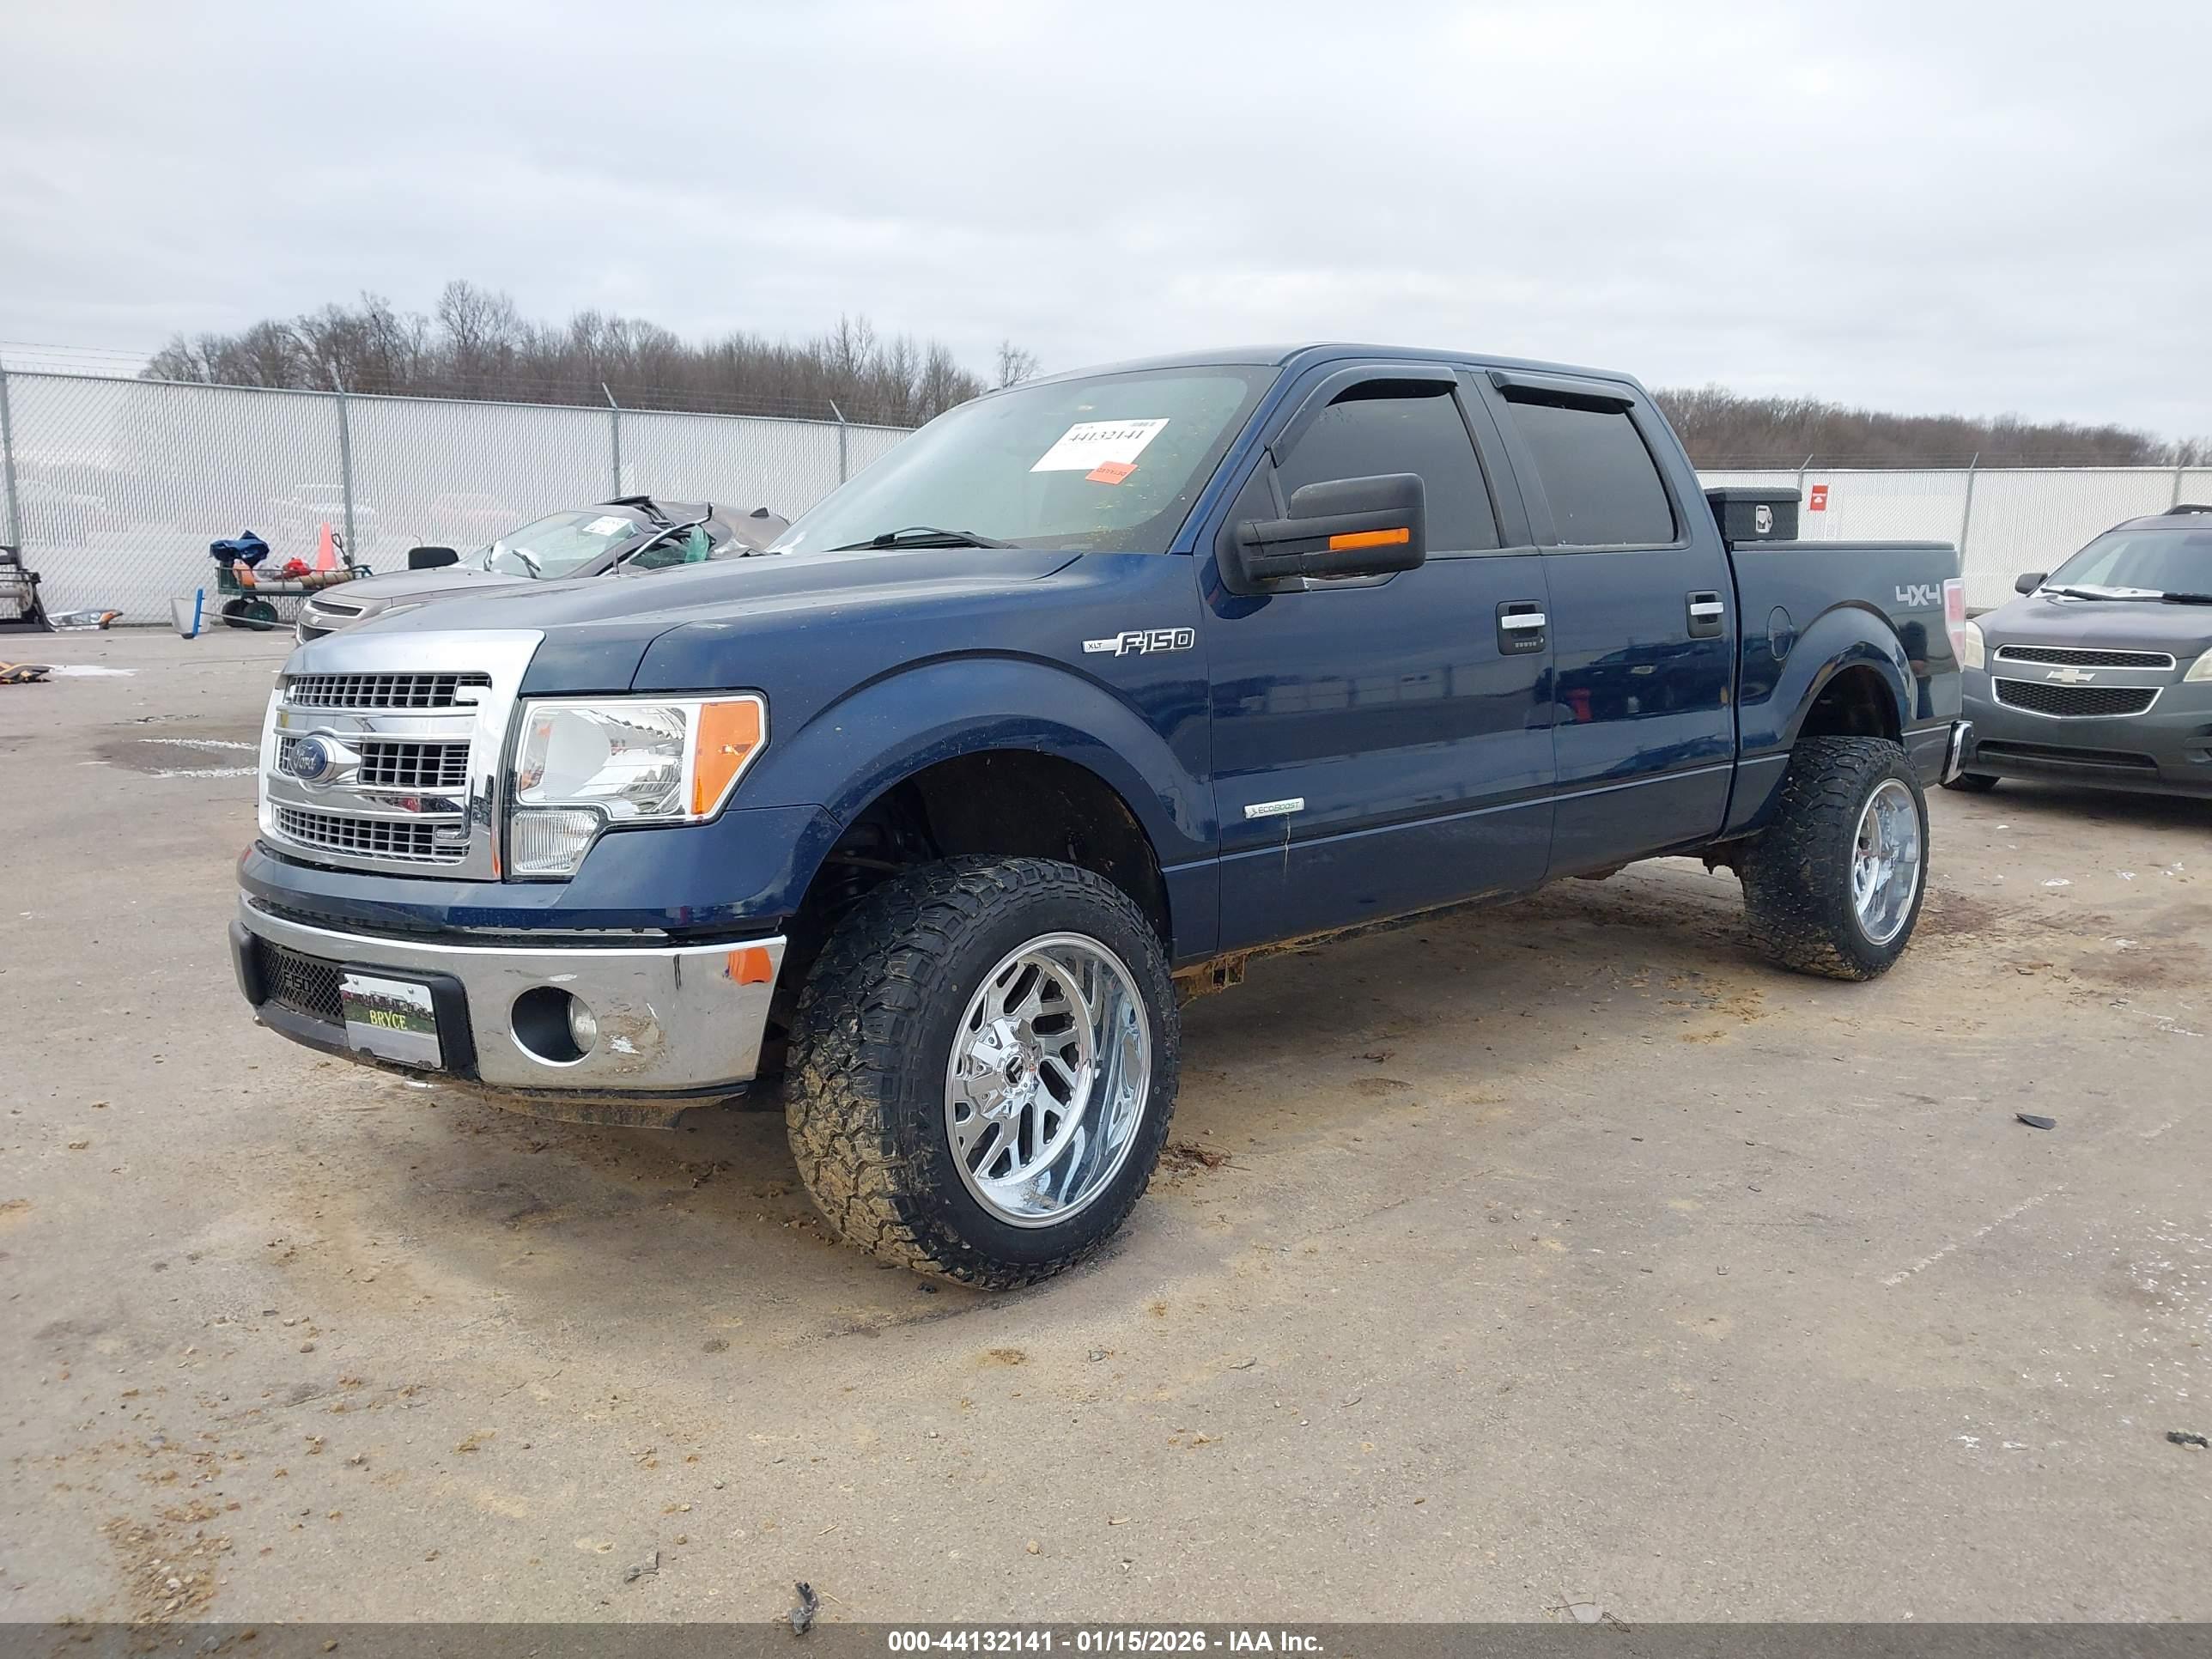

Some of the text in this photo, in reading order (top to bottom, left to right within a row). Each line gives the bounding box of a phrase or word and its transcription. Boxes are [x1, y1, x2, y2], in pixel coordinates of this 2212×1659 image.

[1068, 429, 1145, 441] 44132141
[1116, 628, 1194, 656] F-150
[293, 747, 317, 770] Ford
[1258, 801, 1299, 814] ECOBOOST
[369, 1009, 408, 1030] BRYCE
